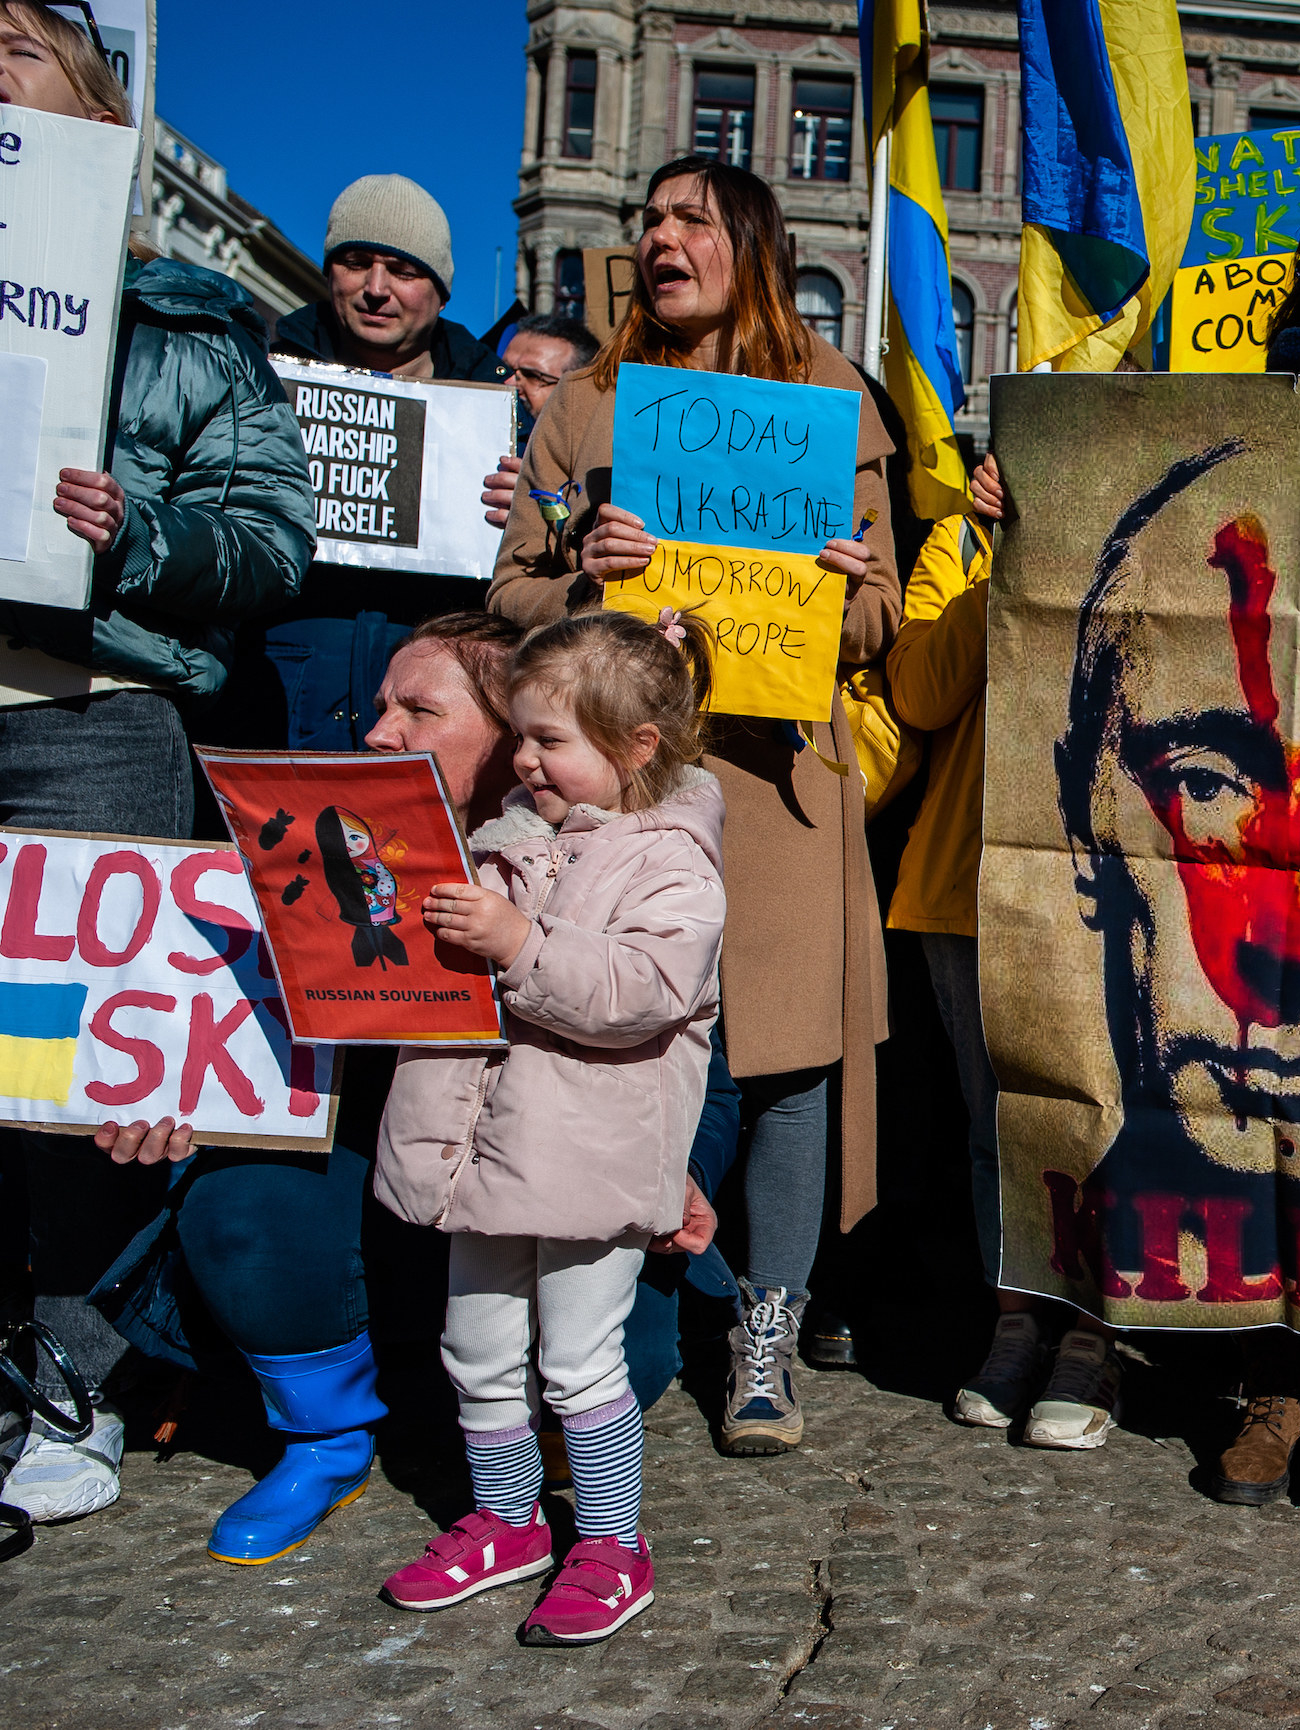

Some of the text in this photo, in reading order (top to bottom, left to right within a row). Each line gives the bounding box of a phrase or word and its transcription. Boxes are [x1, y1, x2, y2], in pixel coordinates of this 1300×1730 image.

[1194, 259, 1286, 295] ABO
[295, 386, 396, 430] RUSSIAN
[634, 389, 810, 463] TODAY
[308, 460, 391, 501] O FUCK
[314, 497, 398, 539] URSELF.
[656, 474, 847, 538] UKRAINE
[620, 543, 827, 607] OMORROW
[716, 617, 806, 659] ROPE
[0, 843, 277, 979] LOS
[305, 988, 471, 1002] RUSSIAN SOUVENIRS
